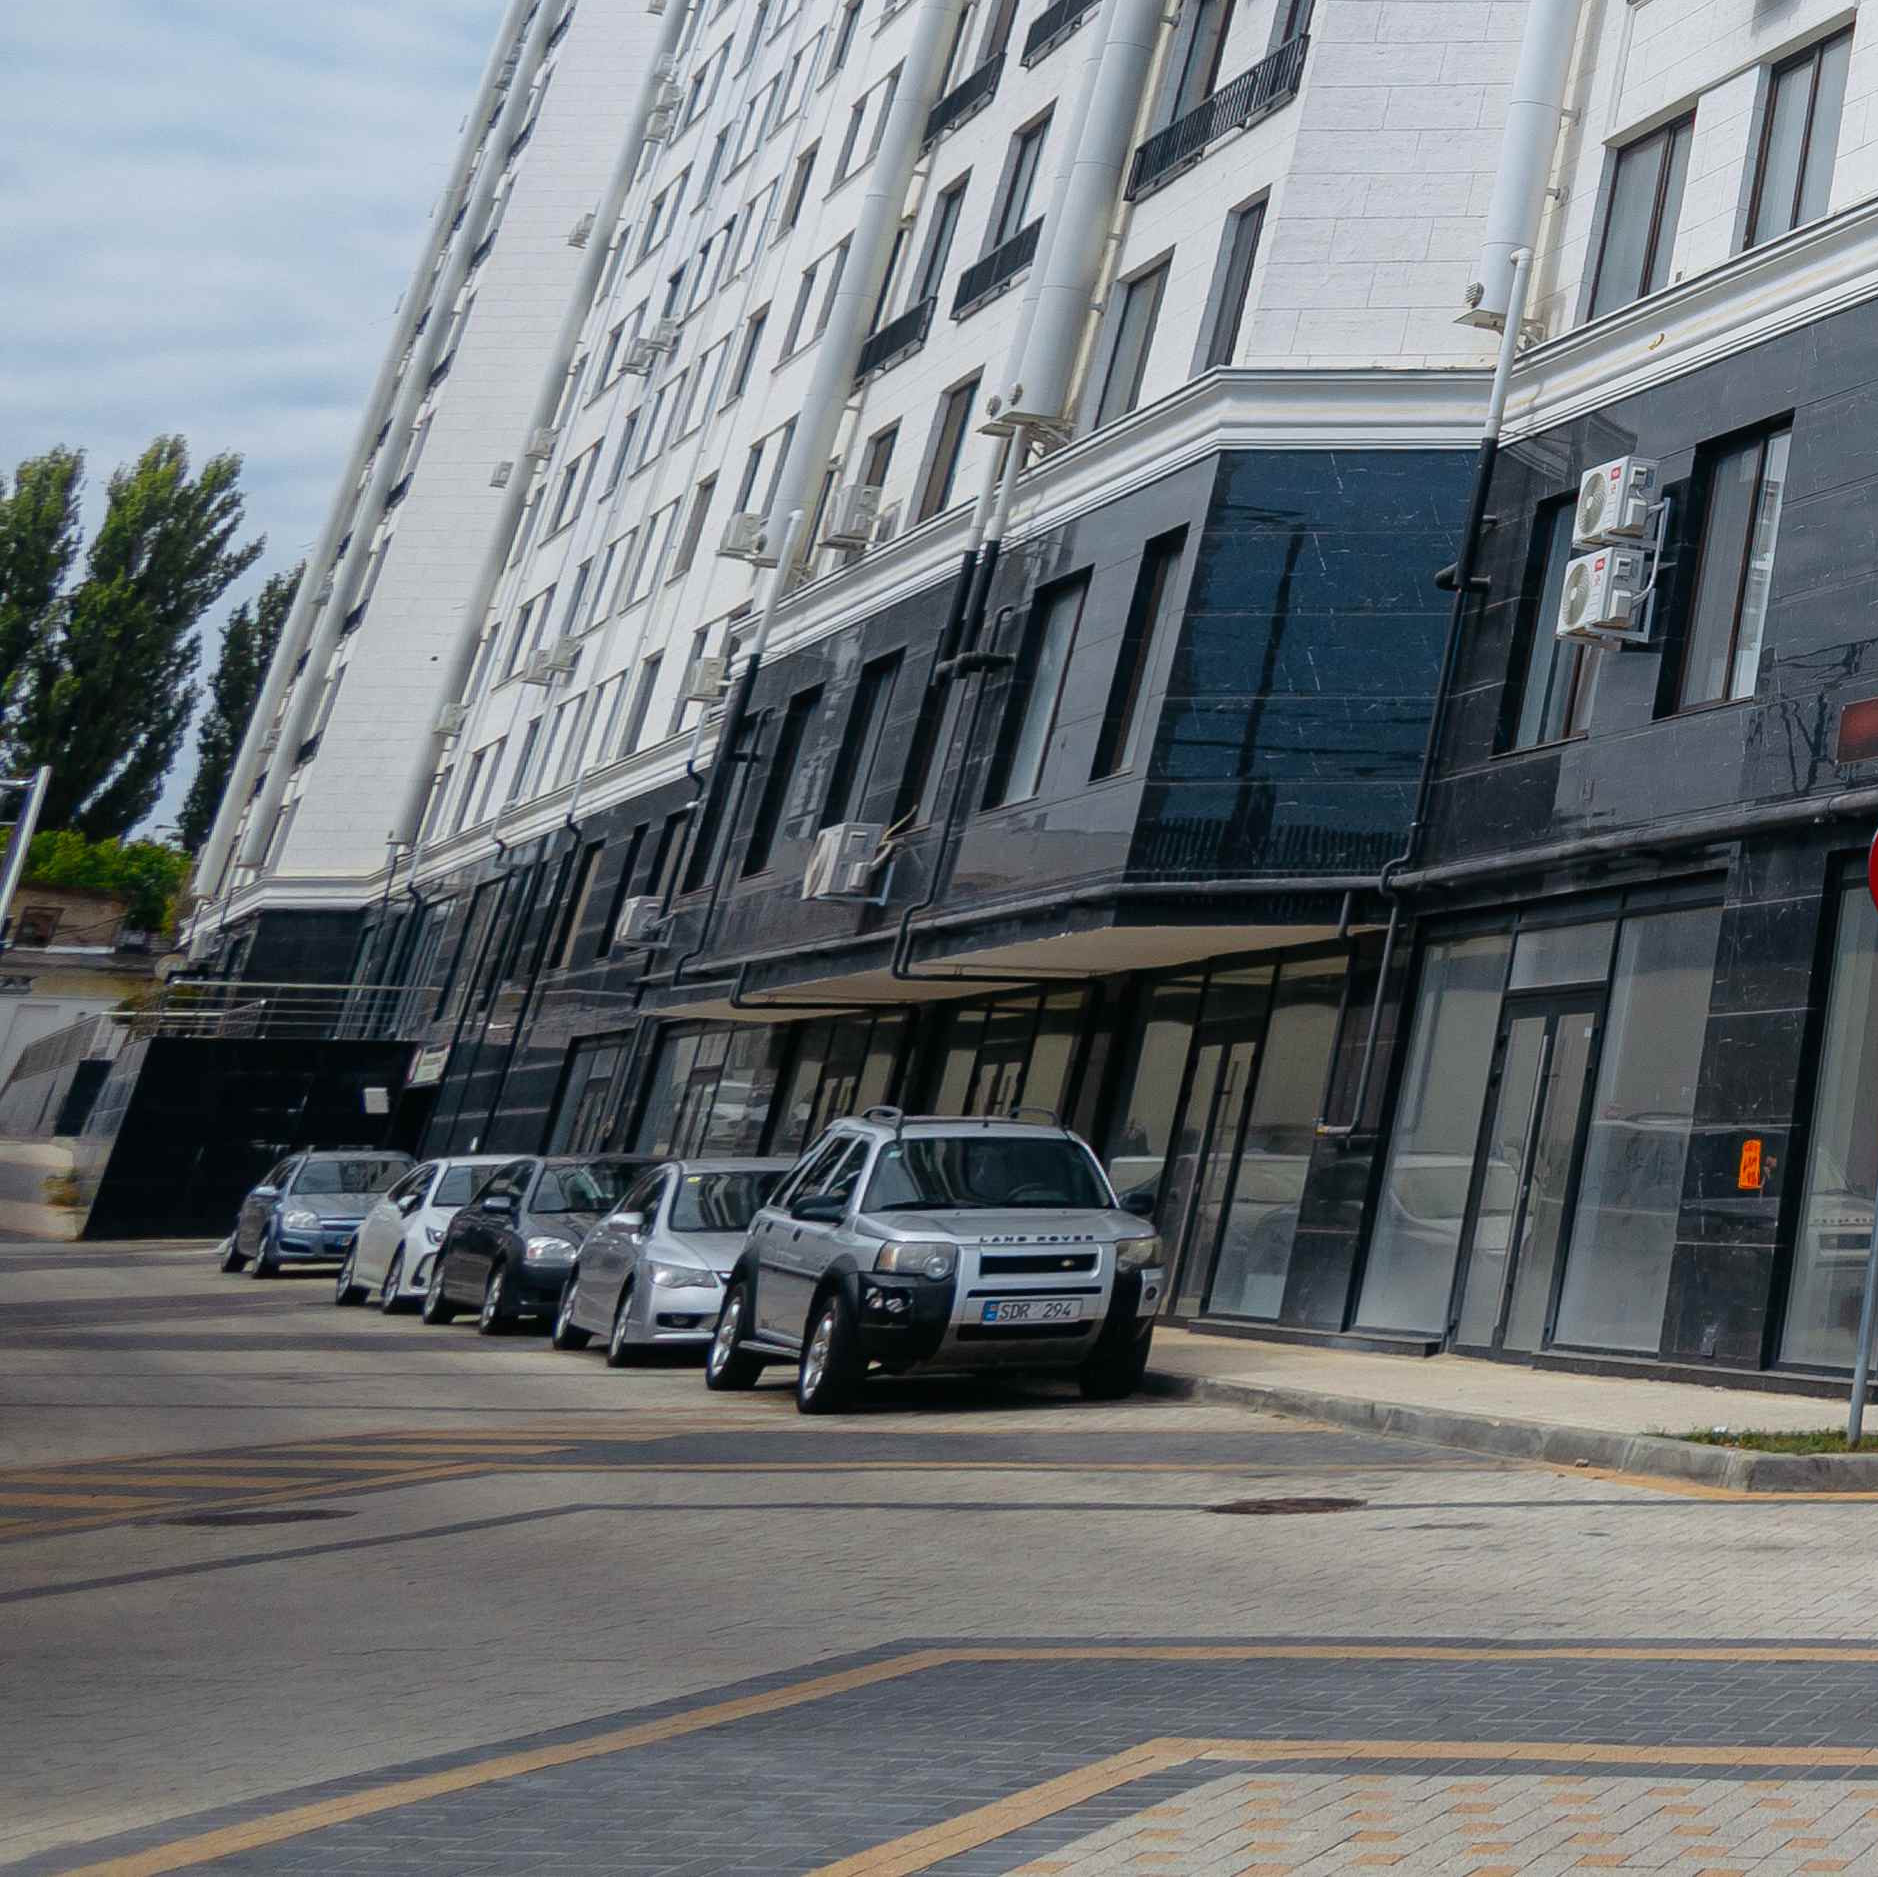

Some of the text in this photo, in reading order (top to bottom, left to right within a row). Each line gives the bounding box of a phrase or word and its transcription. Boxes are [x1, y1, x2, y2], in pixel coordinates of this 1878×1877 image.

[980, 1234, 1094, 1243] LAND ROVER
[1000, 1302, 1072, 1320] SDR 294
